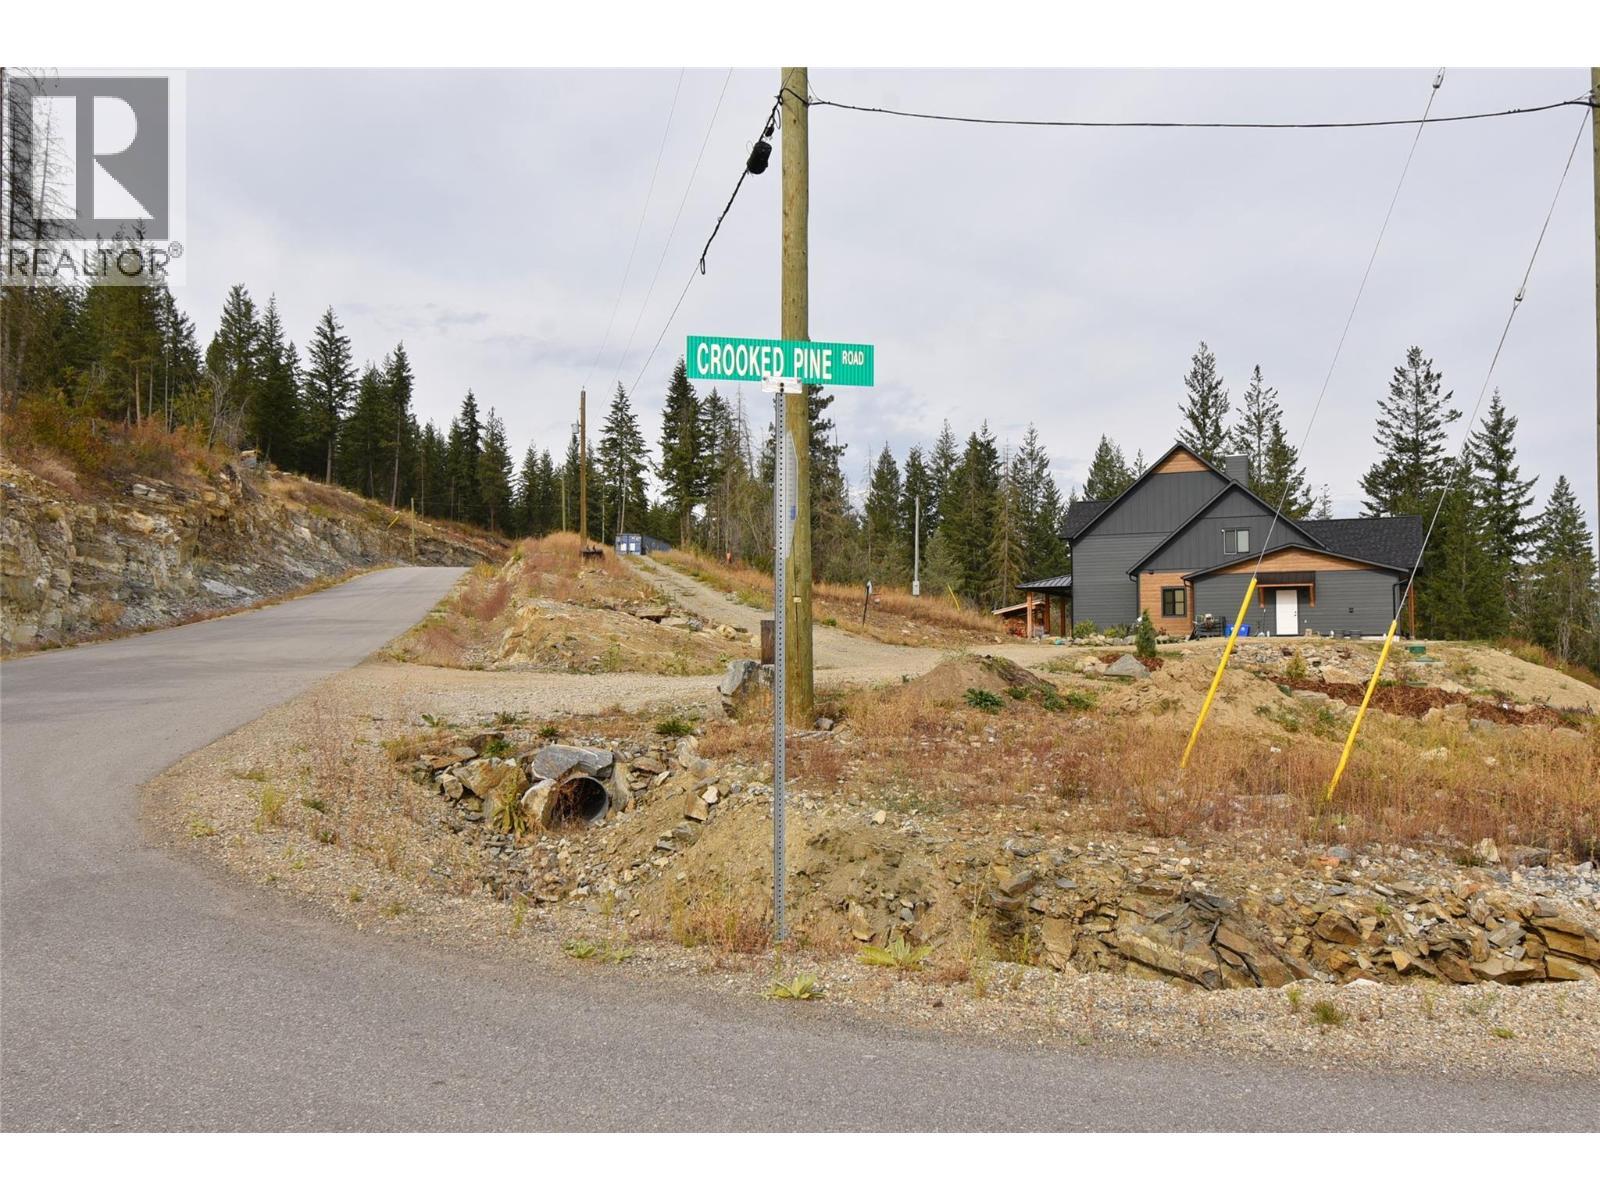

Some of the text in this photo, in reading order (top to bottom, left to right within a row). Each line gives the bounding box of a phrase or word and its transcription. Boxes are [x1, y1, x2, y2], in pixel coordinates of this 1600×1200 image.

[697, 343, 864, 380] CROOKED PINE ROAD
